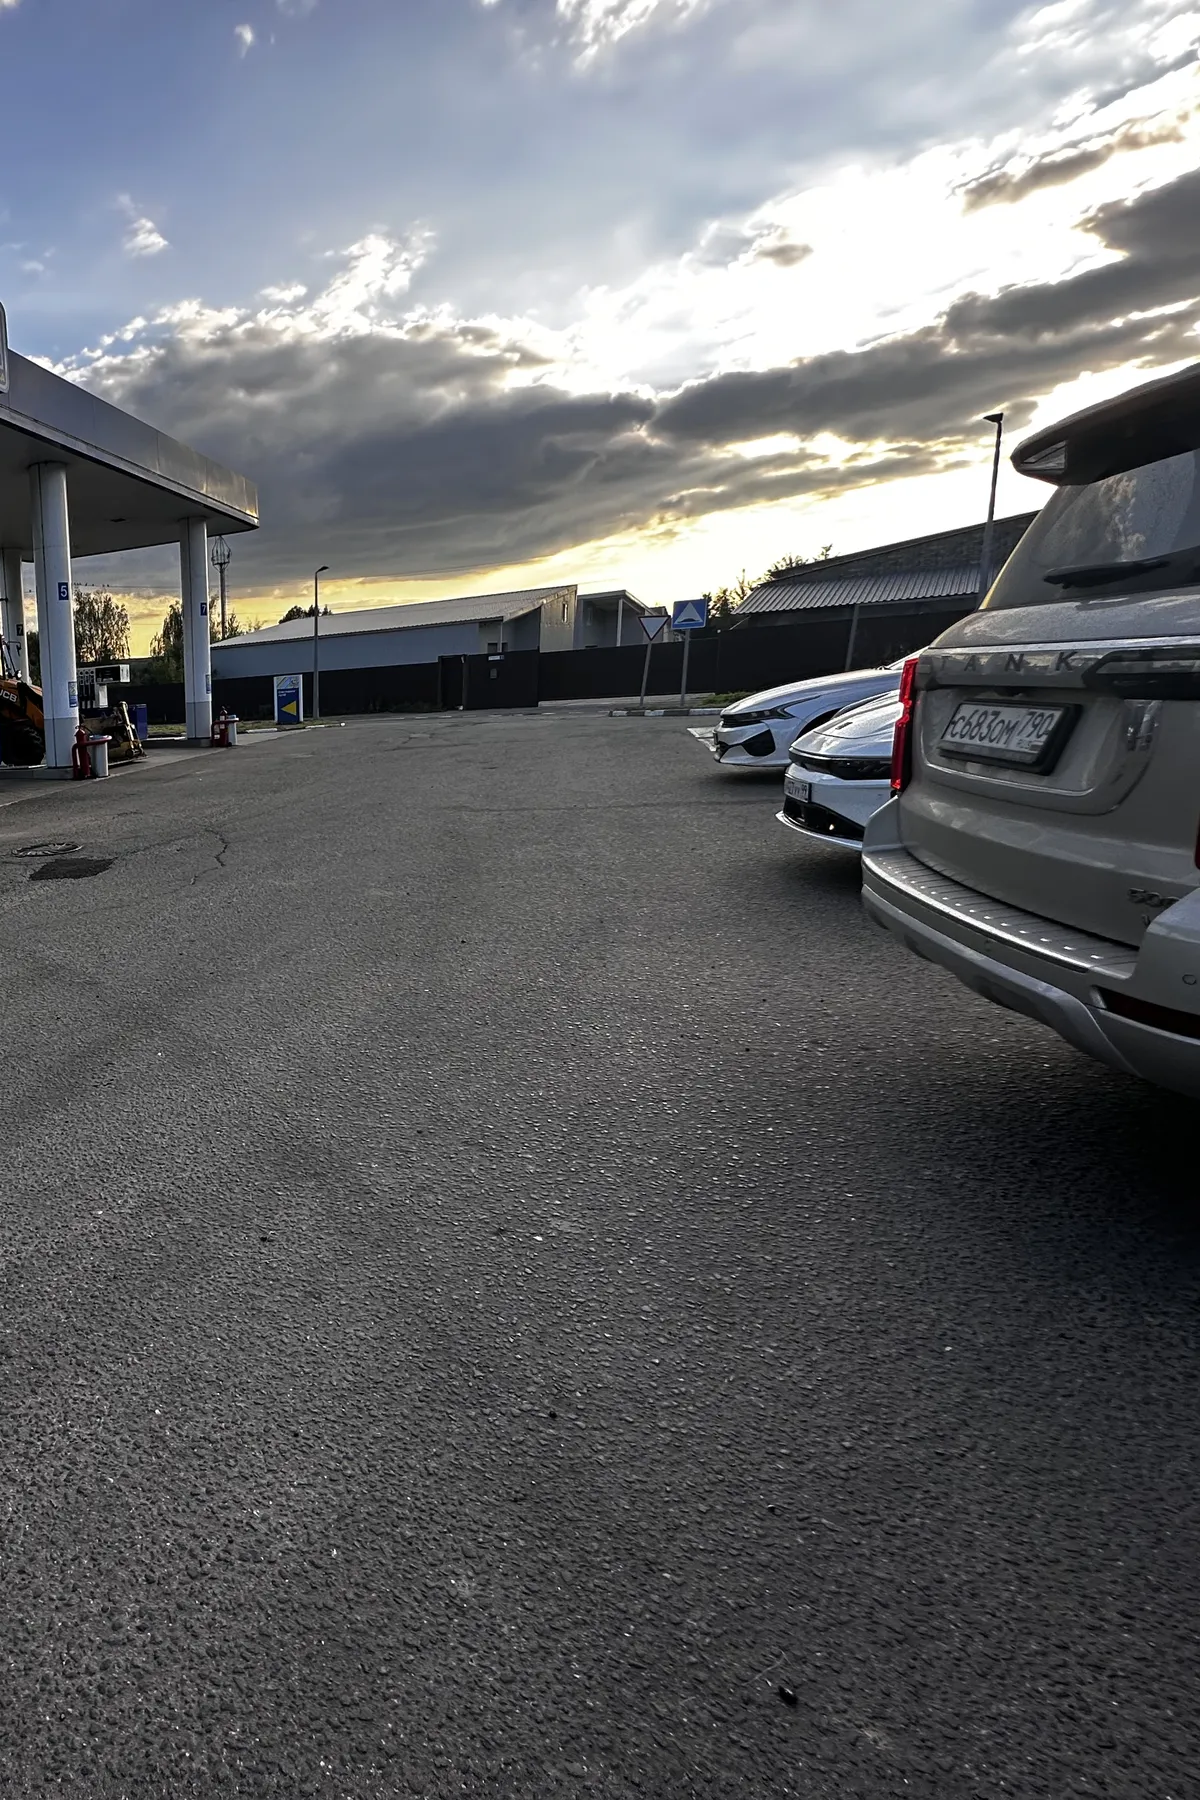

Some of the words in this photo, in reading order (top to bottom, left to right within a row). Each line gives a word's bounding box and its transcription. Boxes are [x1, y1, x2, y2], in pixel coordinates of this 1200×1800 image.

[60, 585, 68, 598] 5
[201, 604, 207, 614] 7
[940, 650, 1078, 672] TANK
[1017, 710, 1055, 739] 790
